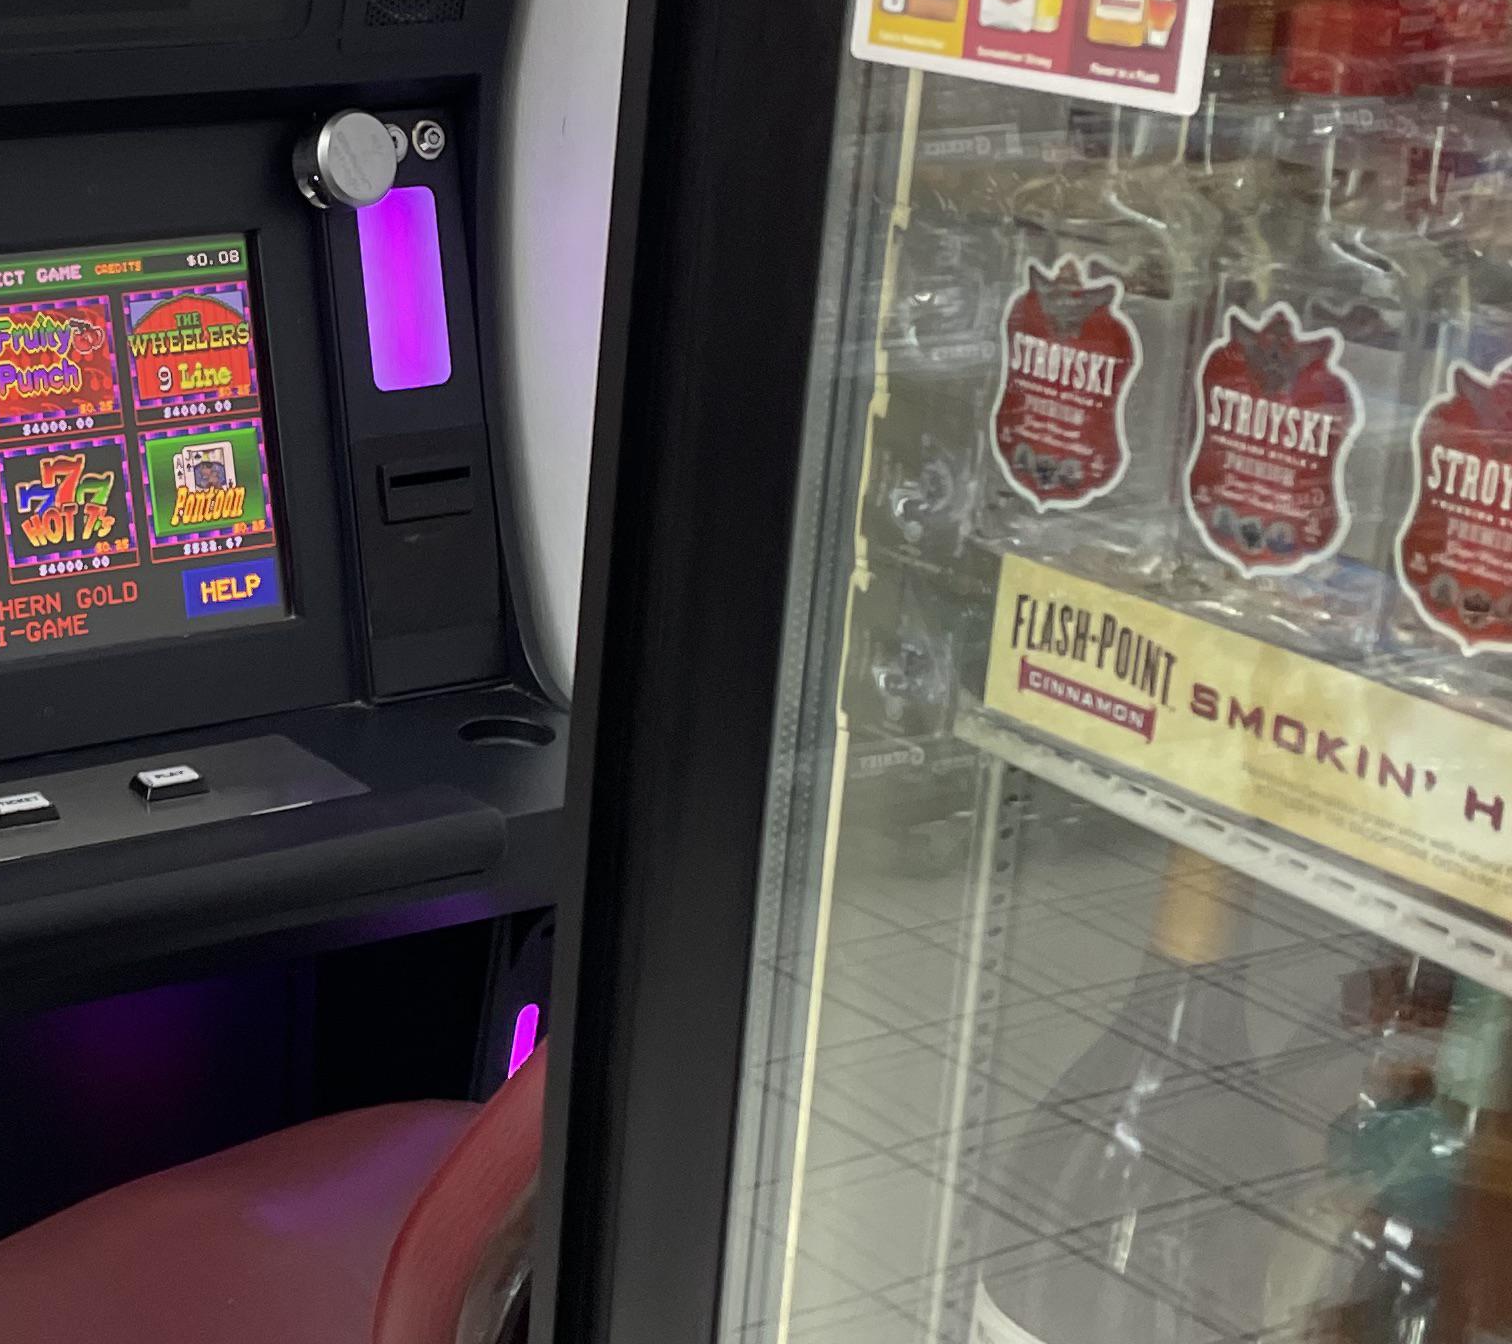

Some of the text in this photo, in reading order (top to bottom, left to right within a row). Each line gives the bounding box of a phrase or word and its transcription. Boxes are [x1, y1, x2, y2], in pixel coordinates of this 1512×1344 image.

[36, 264, 83, 284] GAME
[94, 260, 143, 275] CREDITS
[186, 249, 241, 267] $0.08
[174, 311, 201, 327] THE
[127, 322, 250, 358] WHEELERS
[157, 361, 232, 392] 9 Line
[1011, 332, 1117, 397] STROYSKI
[1207, 386, 1334, 457] STROYSKI
[21, 503, 79, 548] HOT
[170, 485, 247, 527] Pontoon
[77, 581, 139, 609] GOLD
[200, 573, 262, 604] HELP
[1011, 593, 1178, 706] FLASH-POINT
[1190, 682, 1438, 797] SMOKIN'
[1028, 670, 1146, 729] CINNAMON
